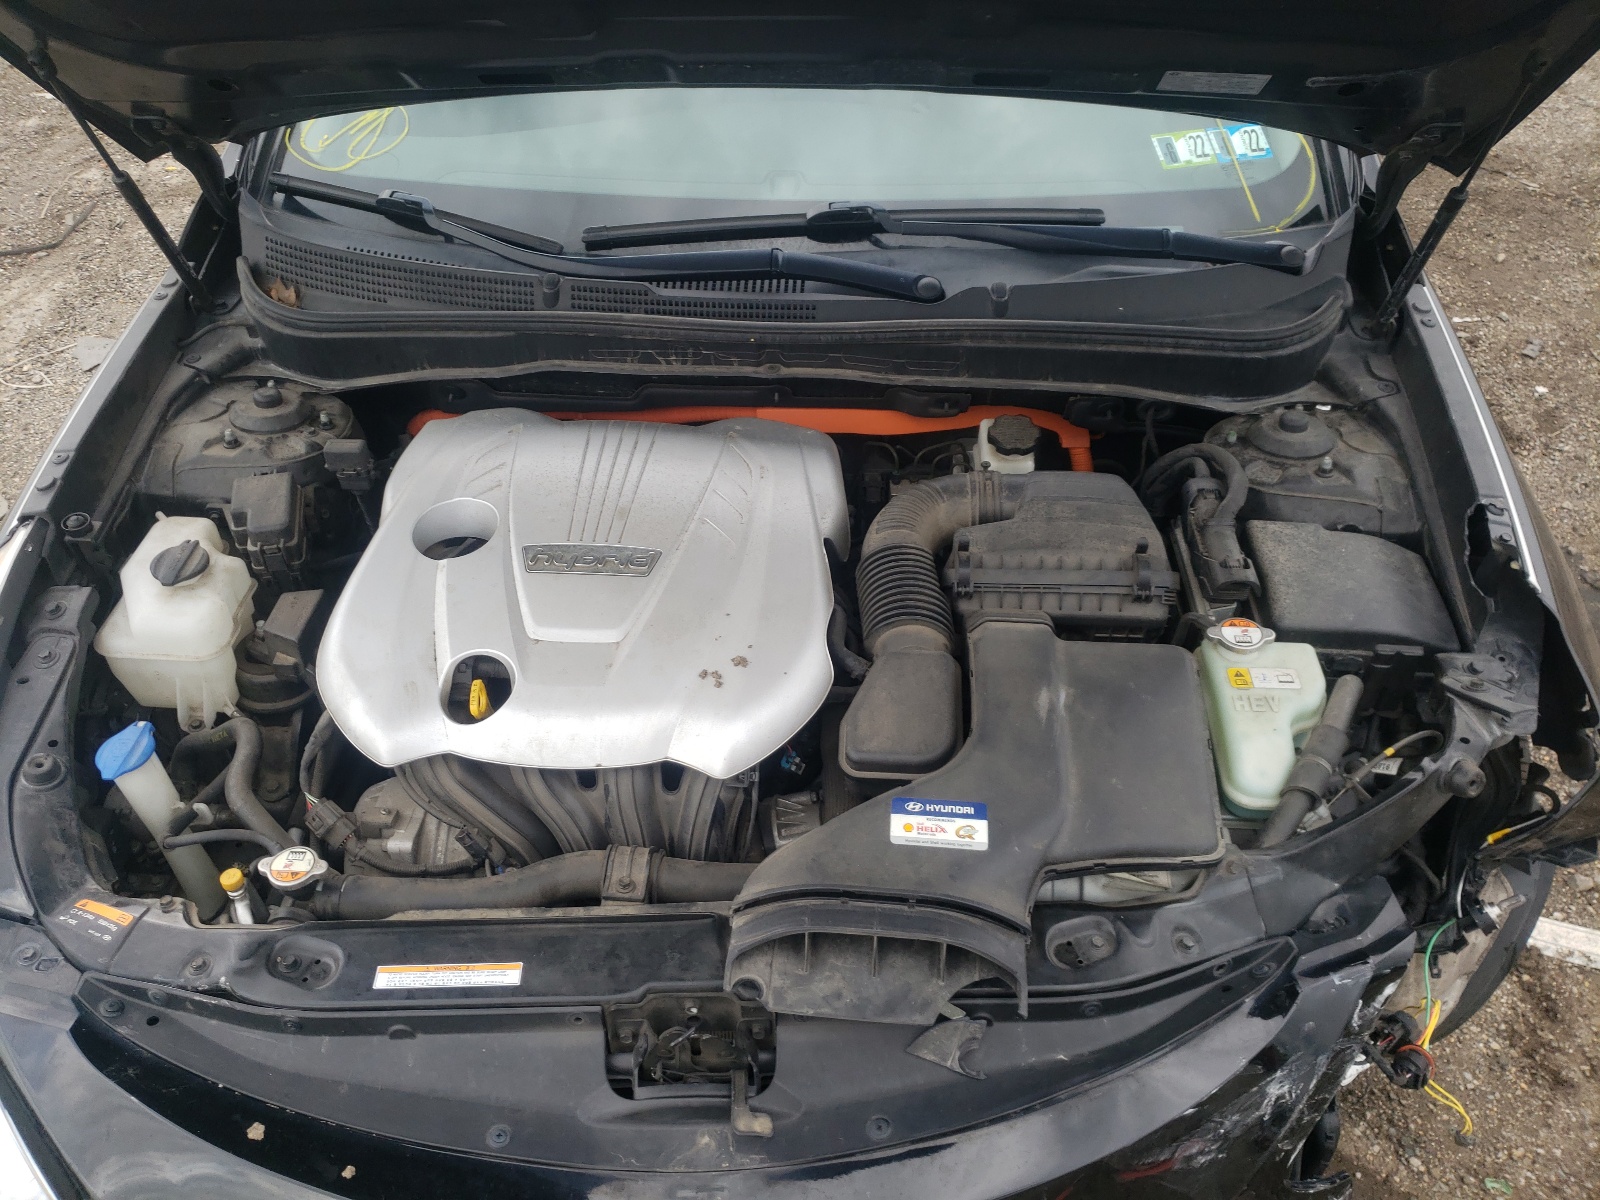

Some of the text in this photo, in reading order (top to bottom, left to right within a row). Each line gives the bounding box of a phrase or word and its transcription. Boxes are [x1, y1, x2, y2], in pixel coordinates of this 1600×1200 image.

[1188, 134, 1210, 159] 22
[1243, 128, 1265, 153] 22
[1231, 695, 1281, 713] HEV
[925, 803, 975, 815] HYUNDAI
[916, 825, 946, 834] HELIX
